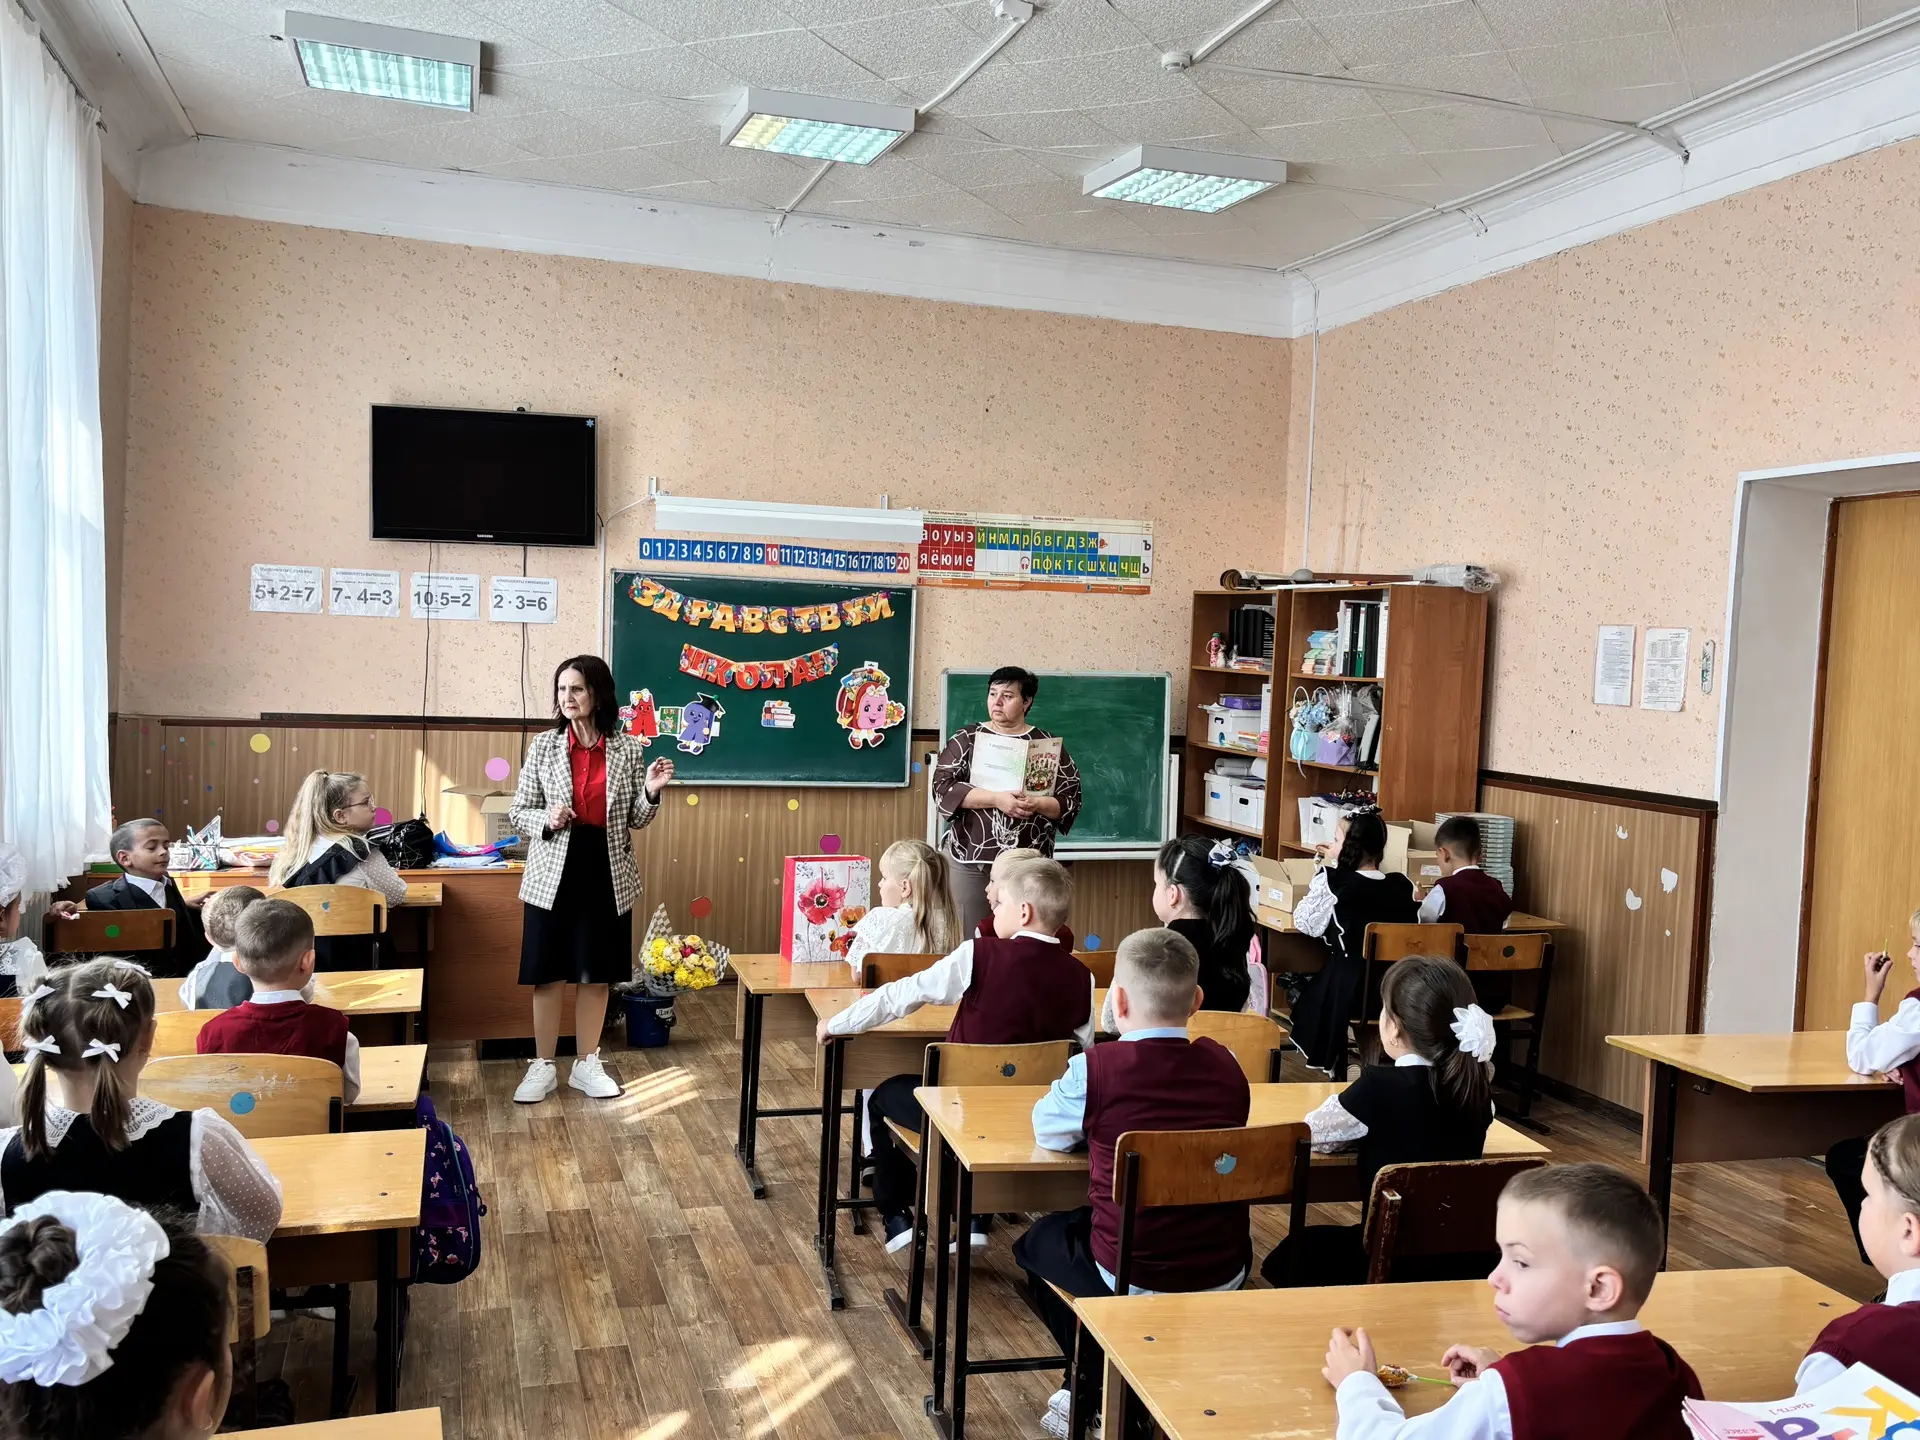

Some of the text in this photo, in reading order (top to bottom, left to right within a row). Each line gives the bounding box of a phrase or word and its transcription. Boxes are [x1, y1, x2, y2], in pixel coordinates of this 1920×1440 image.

[642, 541, 910, 572] 0 1 2 3 4 5 6 7 8 9 10 11 12 13 14 15 16 17 18 19 20
[919, 550, 1150, 576] я ё ю и е п ф к т с ш х ц ч щ ь
[255, 584, 315, 602] 5+2=7
